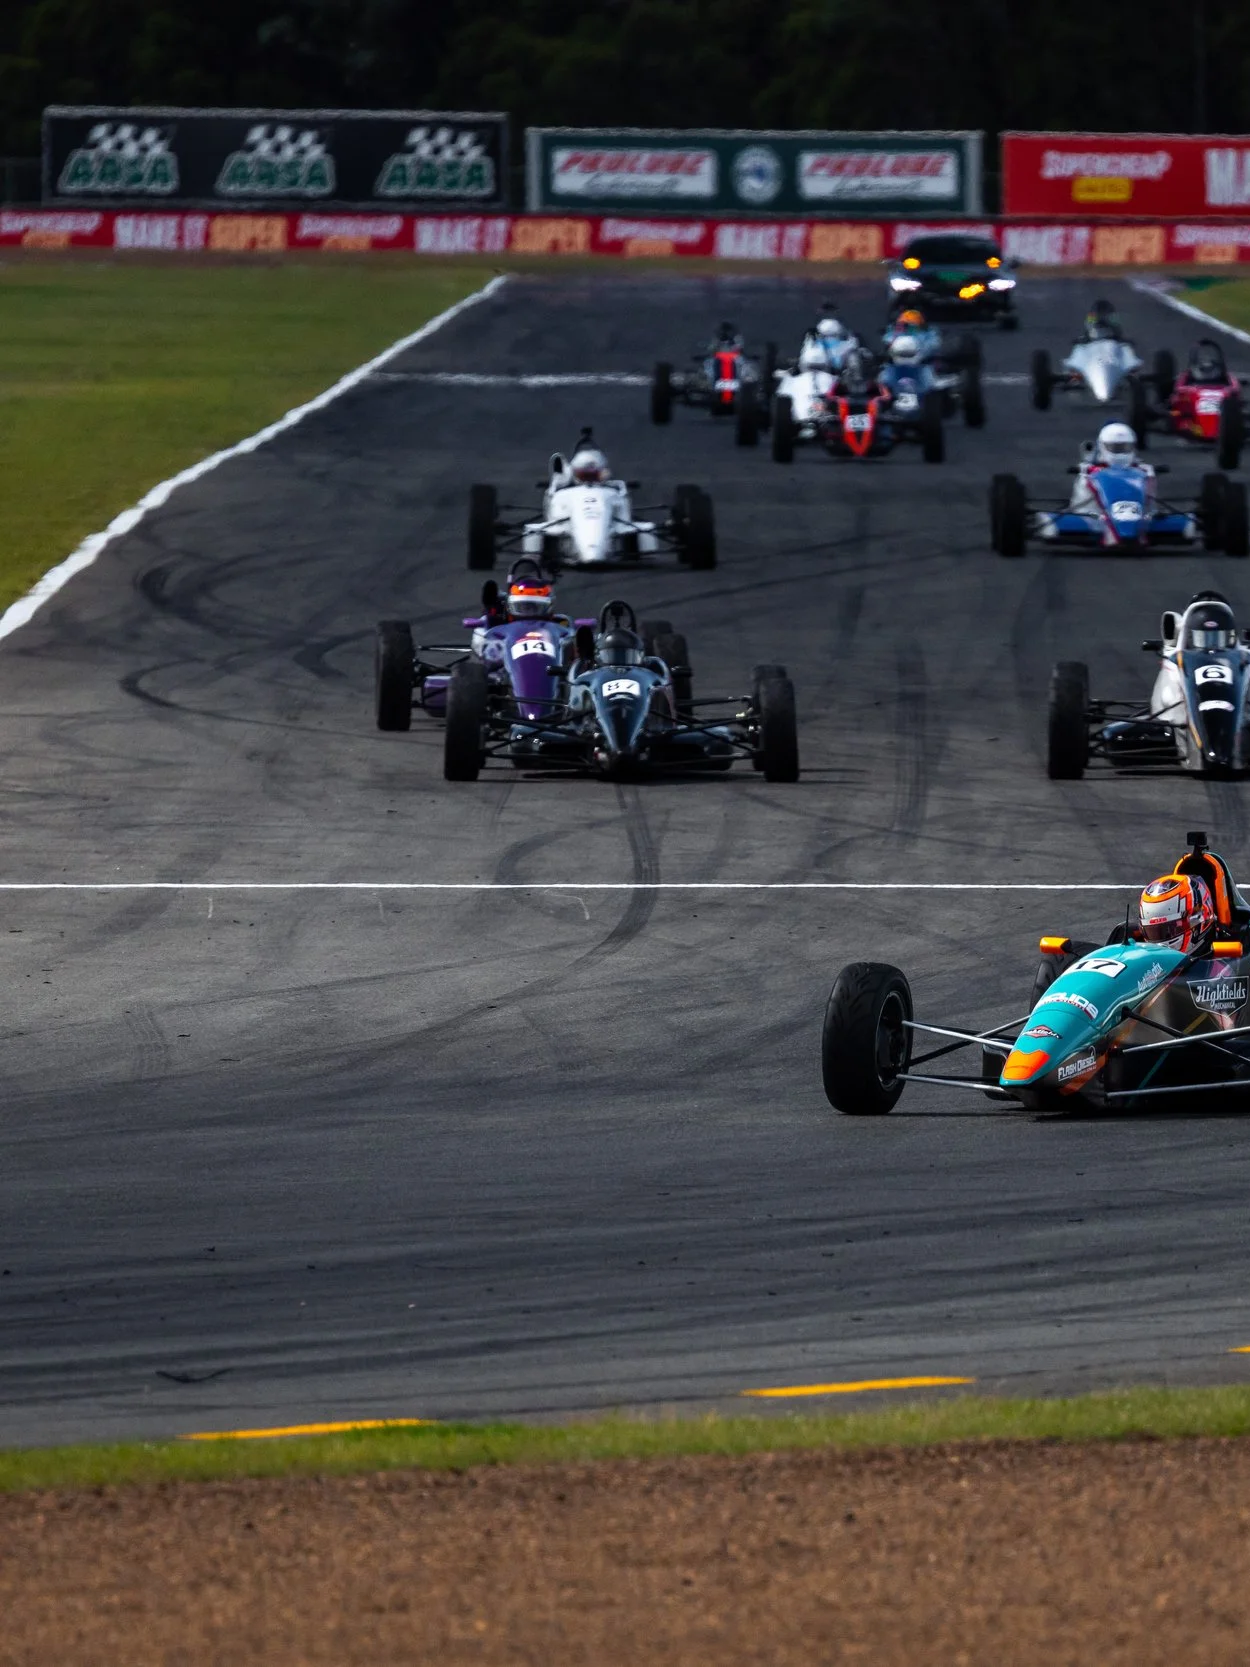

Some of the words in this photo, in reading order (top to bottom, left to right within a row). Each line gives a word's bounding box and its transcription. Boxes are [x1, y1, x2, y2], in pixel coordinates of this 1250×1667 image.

[522, 642, 547, 652] 14
[1202, 666, 1226, 679] 6
[607, 682, 635, 692] 87
[1074, 960, 1119, 970] 17
[1196, 982, 1246, 1006] Highfields
[1058, 1062, 1077, 1079] FLASH
